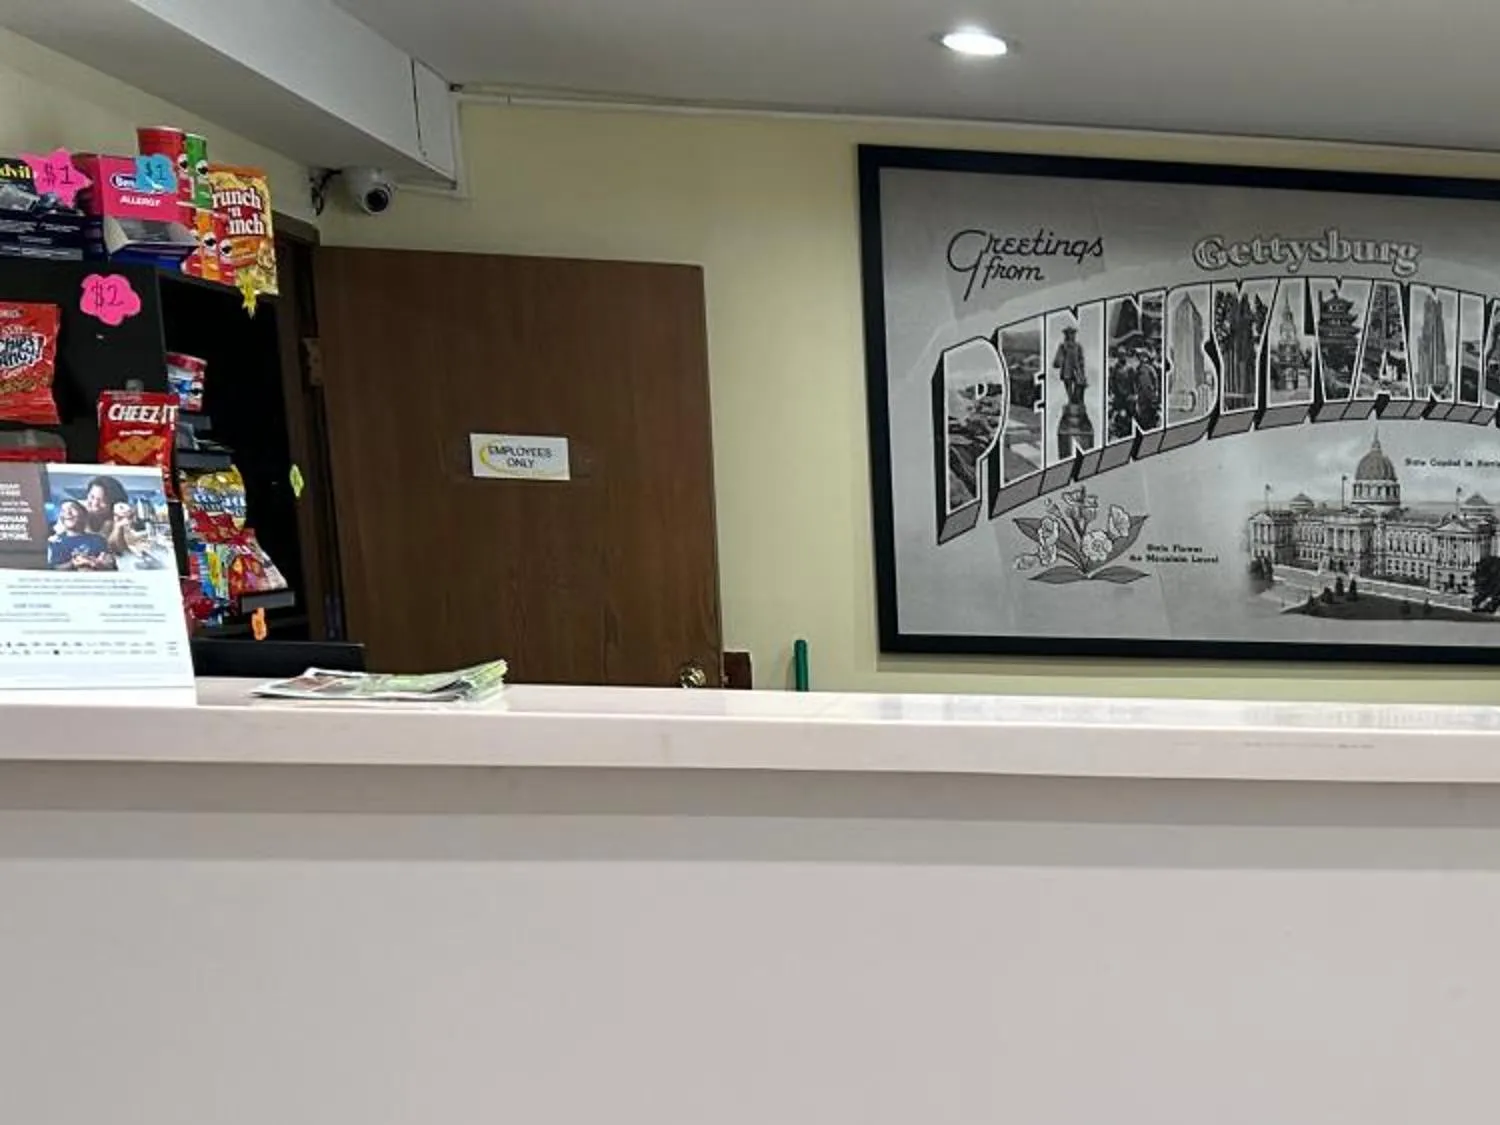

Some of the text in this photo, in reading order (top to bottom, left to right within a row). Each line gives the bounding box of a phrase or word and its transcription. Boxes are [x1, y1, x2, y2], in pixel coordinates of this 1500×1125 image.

[0, 163, 32, 179] dvil
[42, 162, 76, 187] $1
[120, 195, 161, 207] ALLERGY
[211, 187, 263, 210] runch
[226, 213, 265, 235] nch
[1192, 227, 1422, 277] Gettysburg
[947, 228, 1104, 301] Greetings
[981, 255, 1046, 289] from
[90, 283, 125, 310] $2
[487, 445, 553, 458] EMPLOYEES
[507, 458, 535, 468] ONLY
